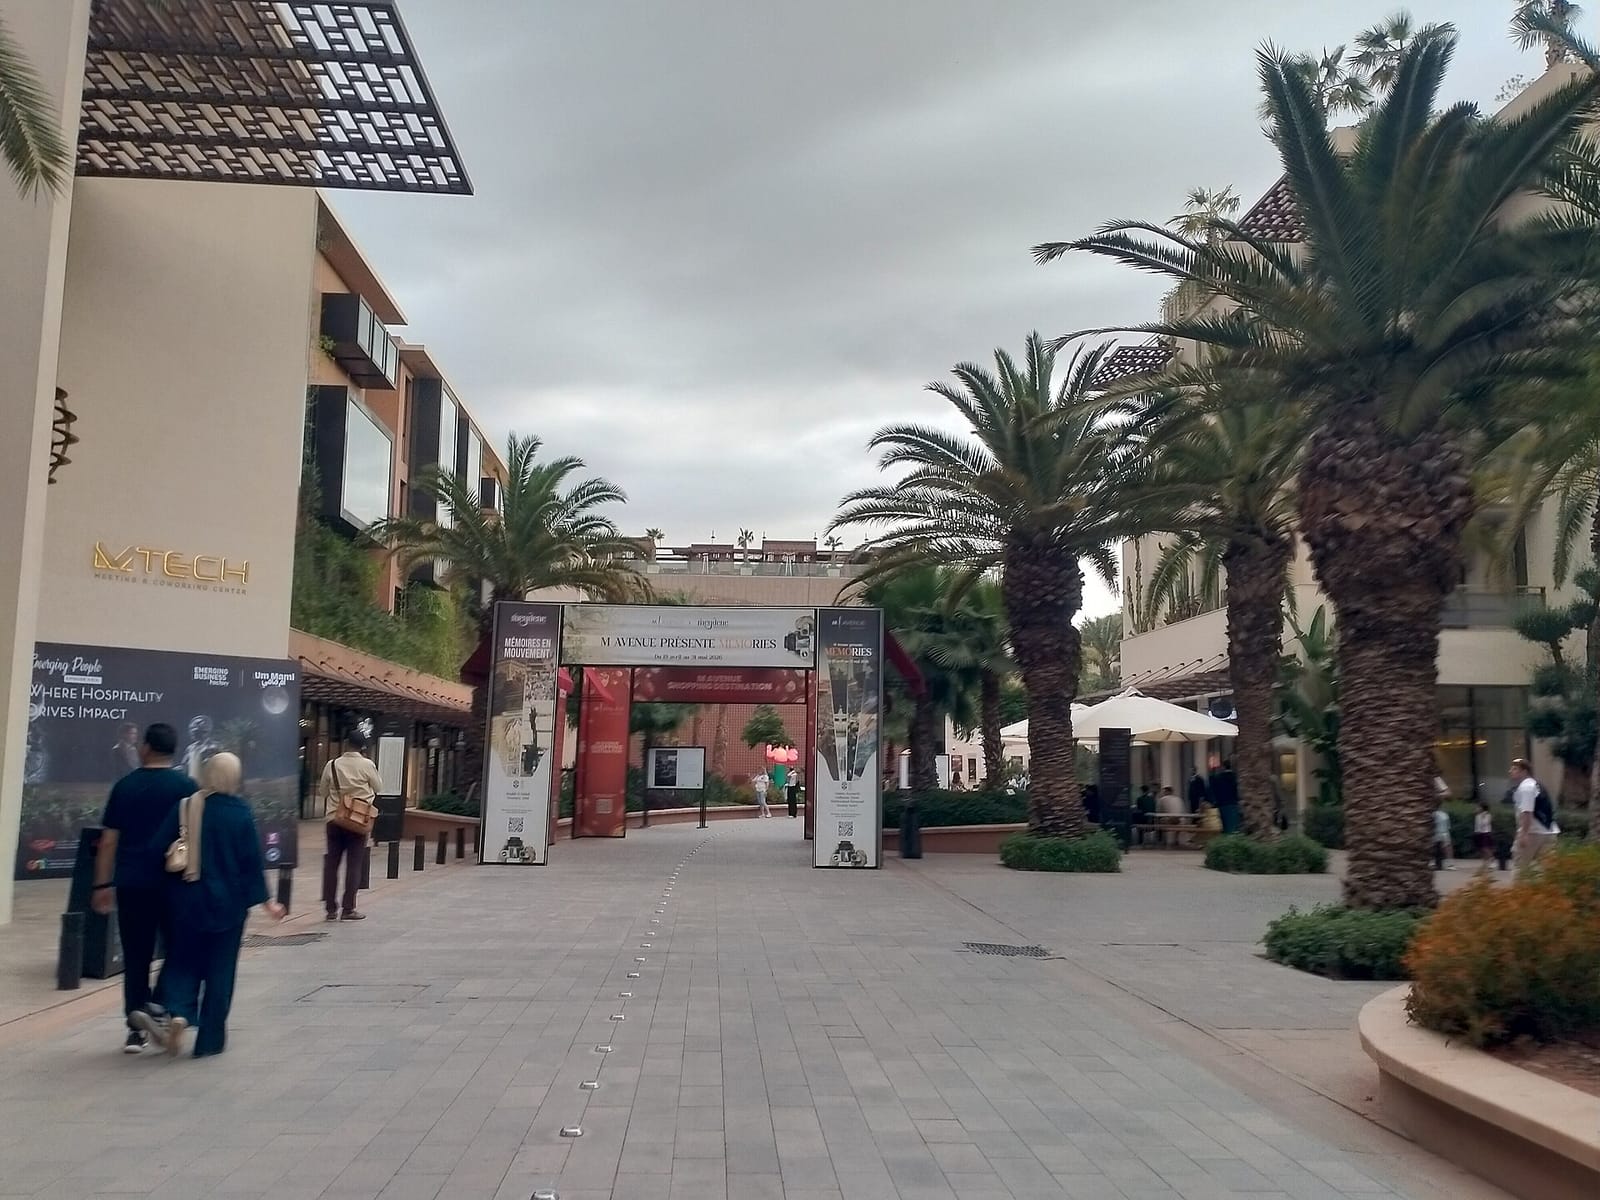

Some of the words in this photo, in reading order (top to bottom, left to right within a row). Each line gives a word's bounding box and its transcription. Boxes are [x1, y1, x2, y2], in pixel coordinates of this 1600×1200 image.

[212, 586, 248, 596] CENTER
[504, 636, 541, 648] MÉMOIRES
[542, 639, 552, 648] EN
[615, 637, 657, 648] AVENUE
[660, 636, 715, 649] PRÉSENTE
[720, 639, 777, 649] MEMORIES
[503, 648, 551, 659] MOUVEMENT
[825, 647, 873, 658] MEMORIES
[71, 657, 103, 676] People
[193, 666, 229, 675] EMERGING
[193, 673, 227, 681] BUSINESS
[30, 684, 78, 700] WHERE
